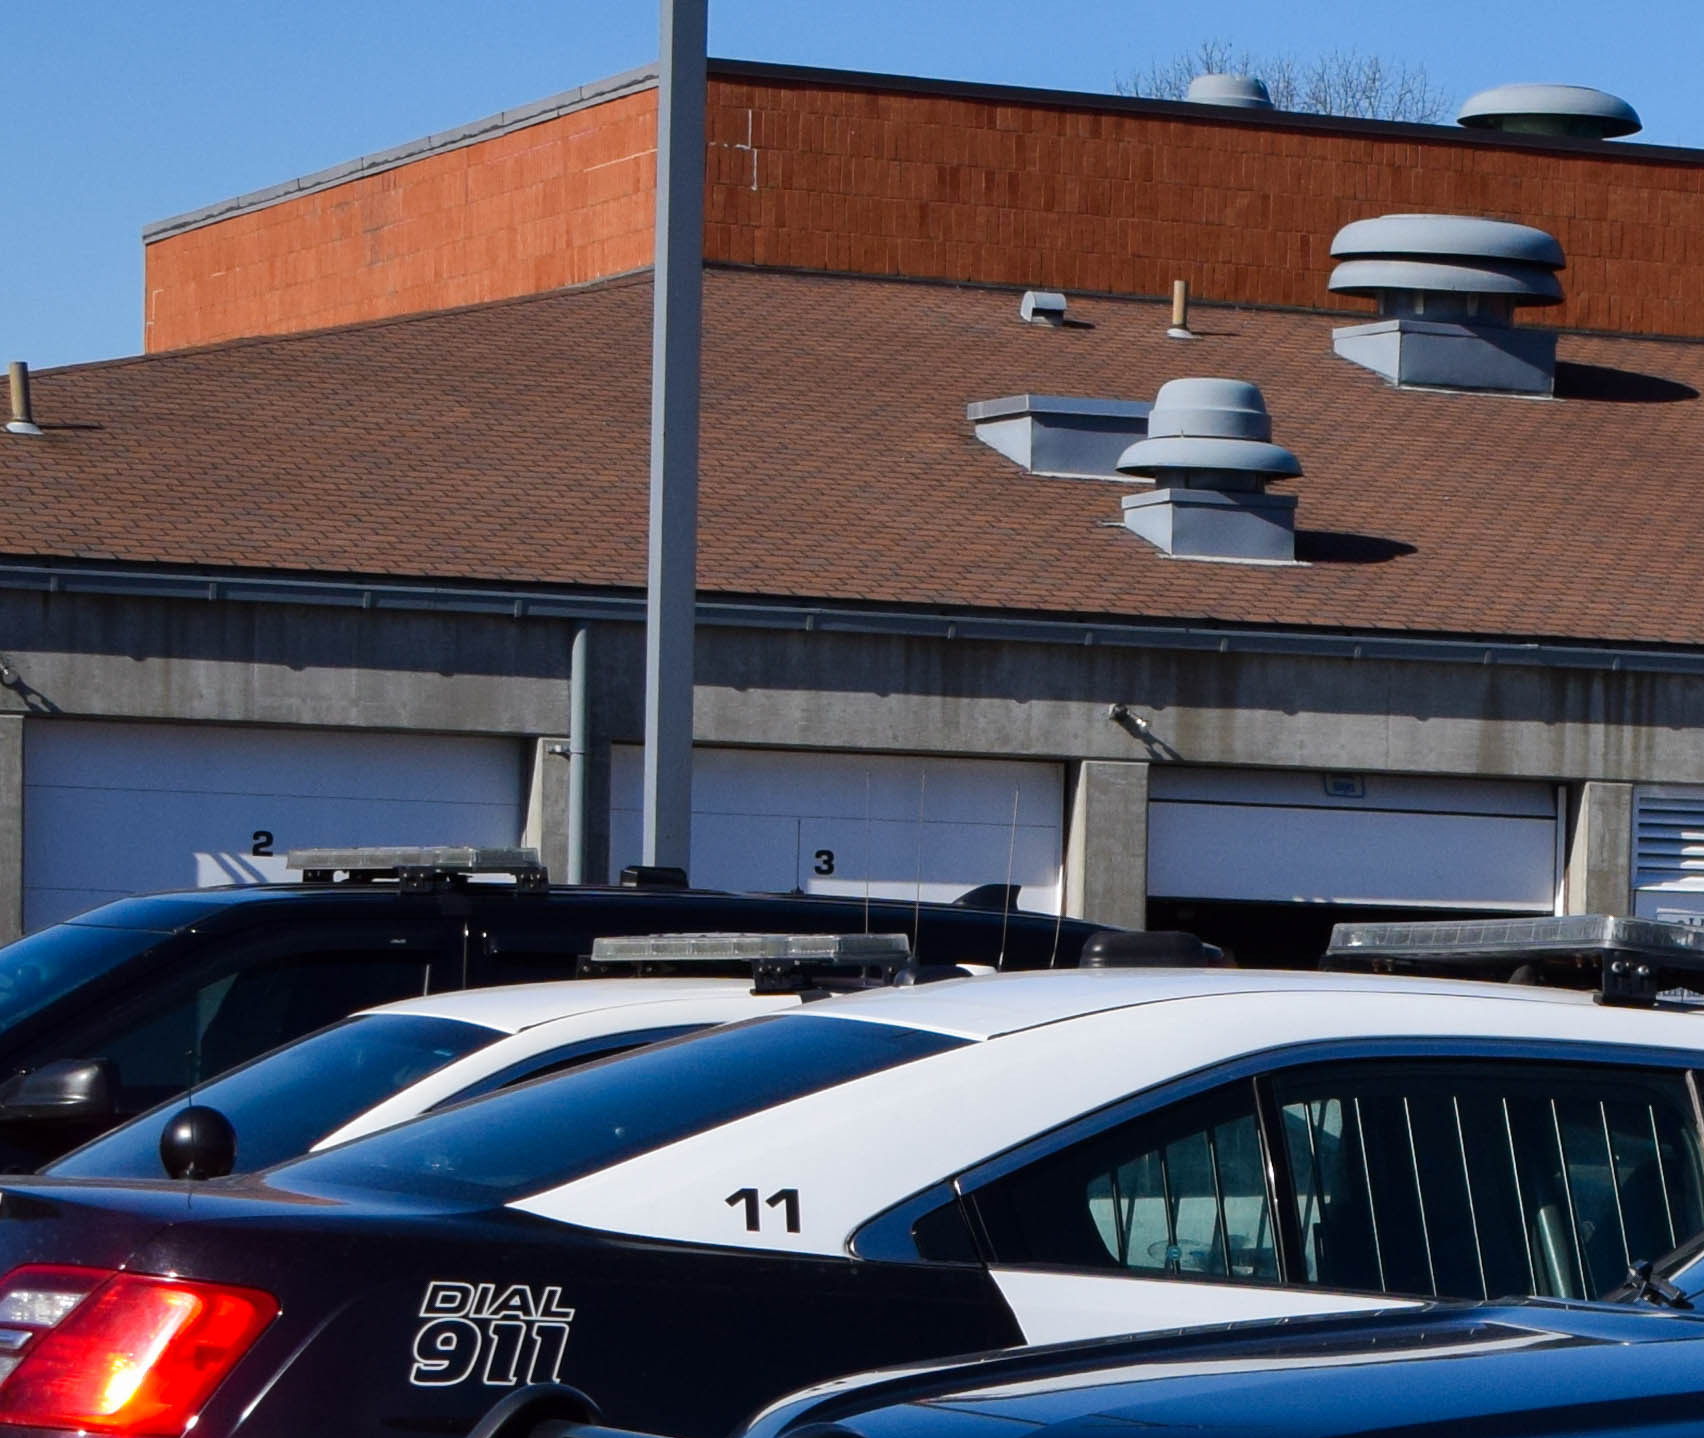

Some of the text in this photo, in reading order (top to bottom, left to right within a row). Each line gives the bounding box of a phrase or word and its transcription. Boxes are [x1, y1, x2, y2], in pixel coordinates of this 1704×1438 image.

[252, 830, 274, 857] 2
[813, 849, 836, 876] 3
[724, 1187, 802, 1235] 11
[418, 1281, 576, 1322] DIAL
[409, 1316, 570, 1387] 911
